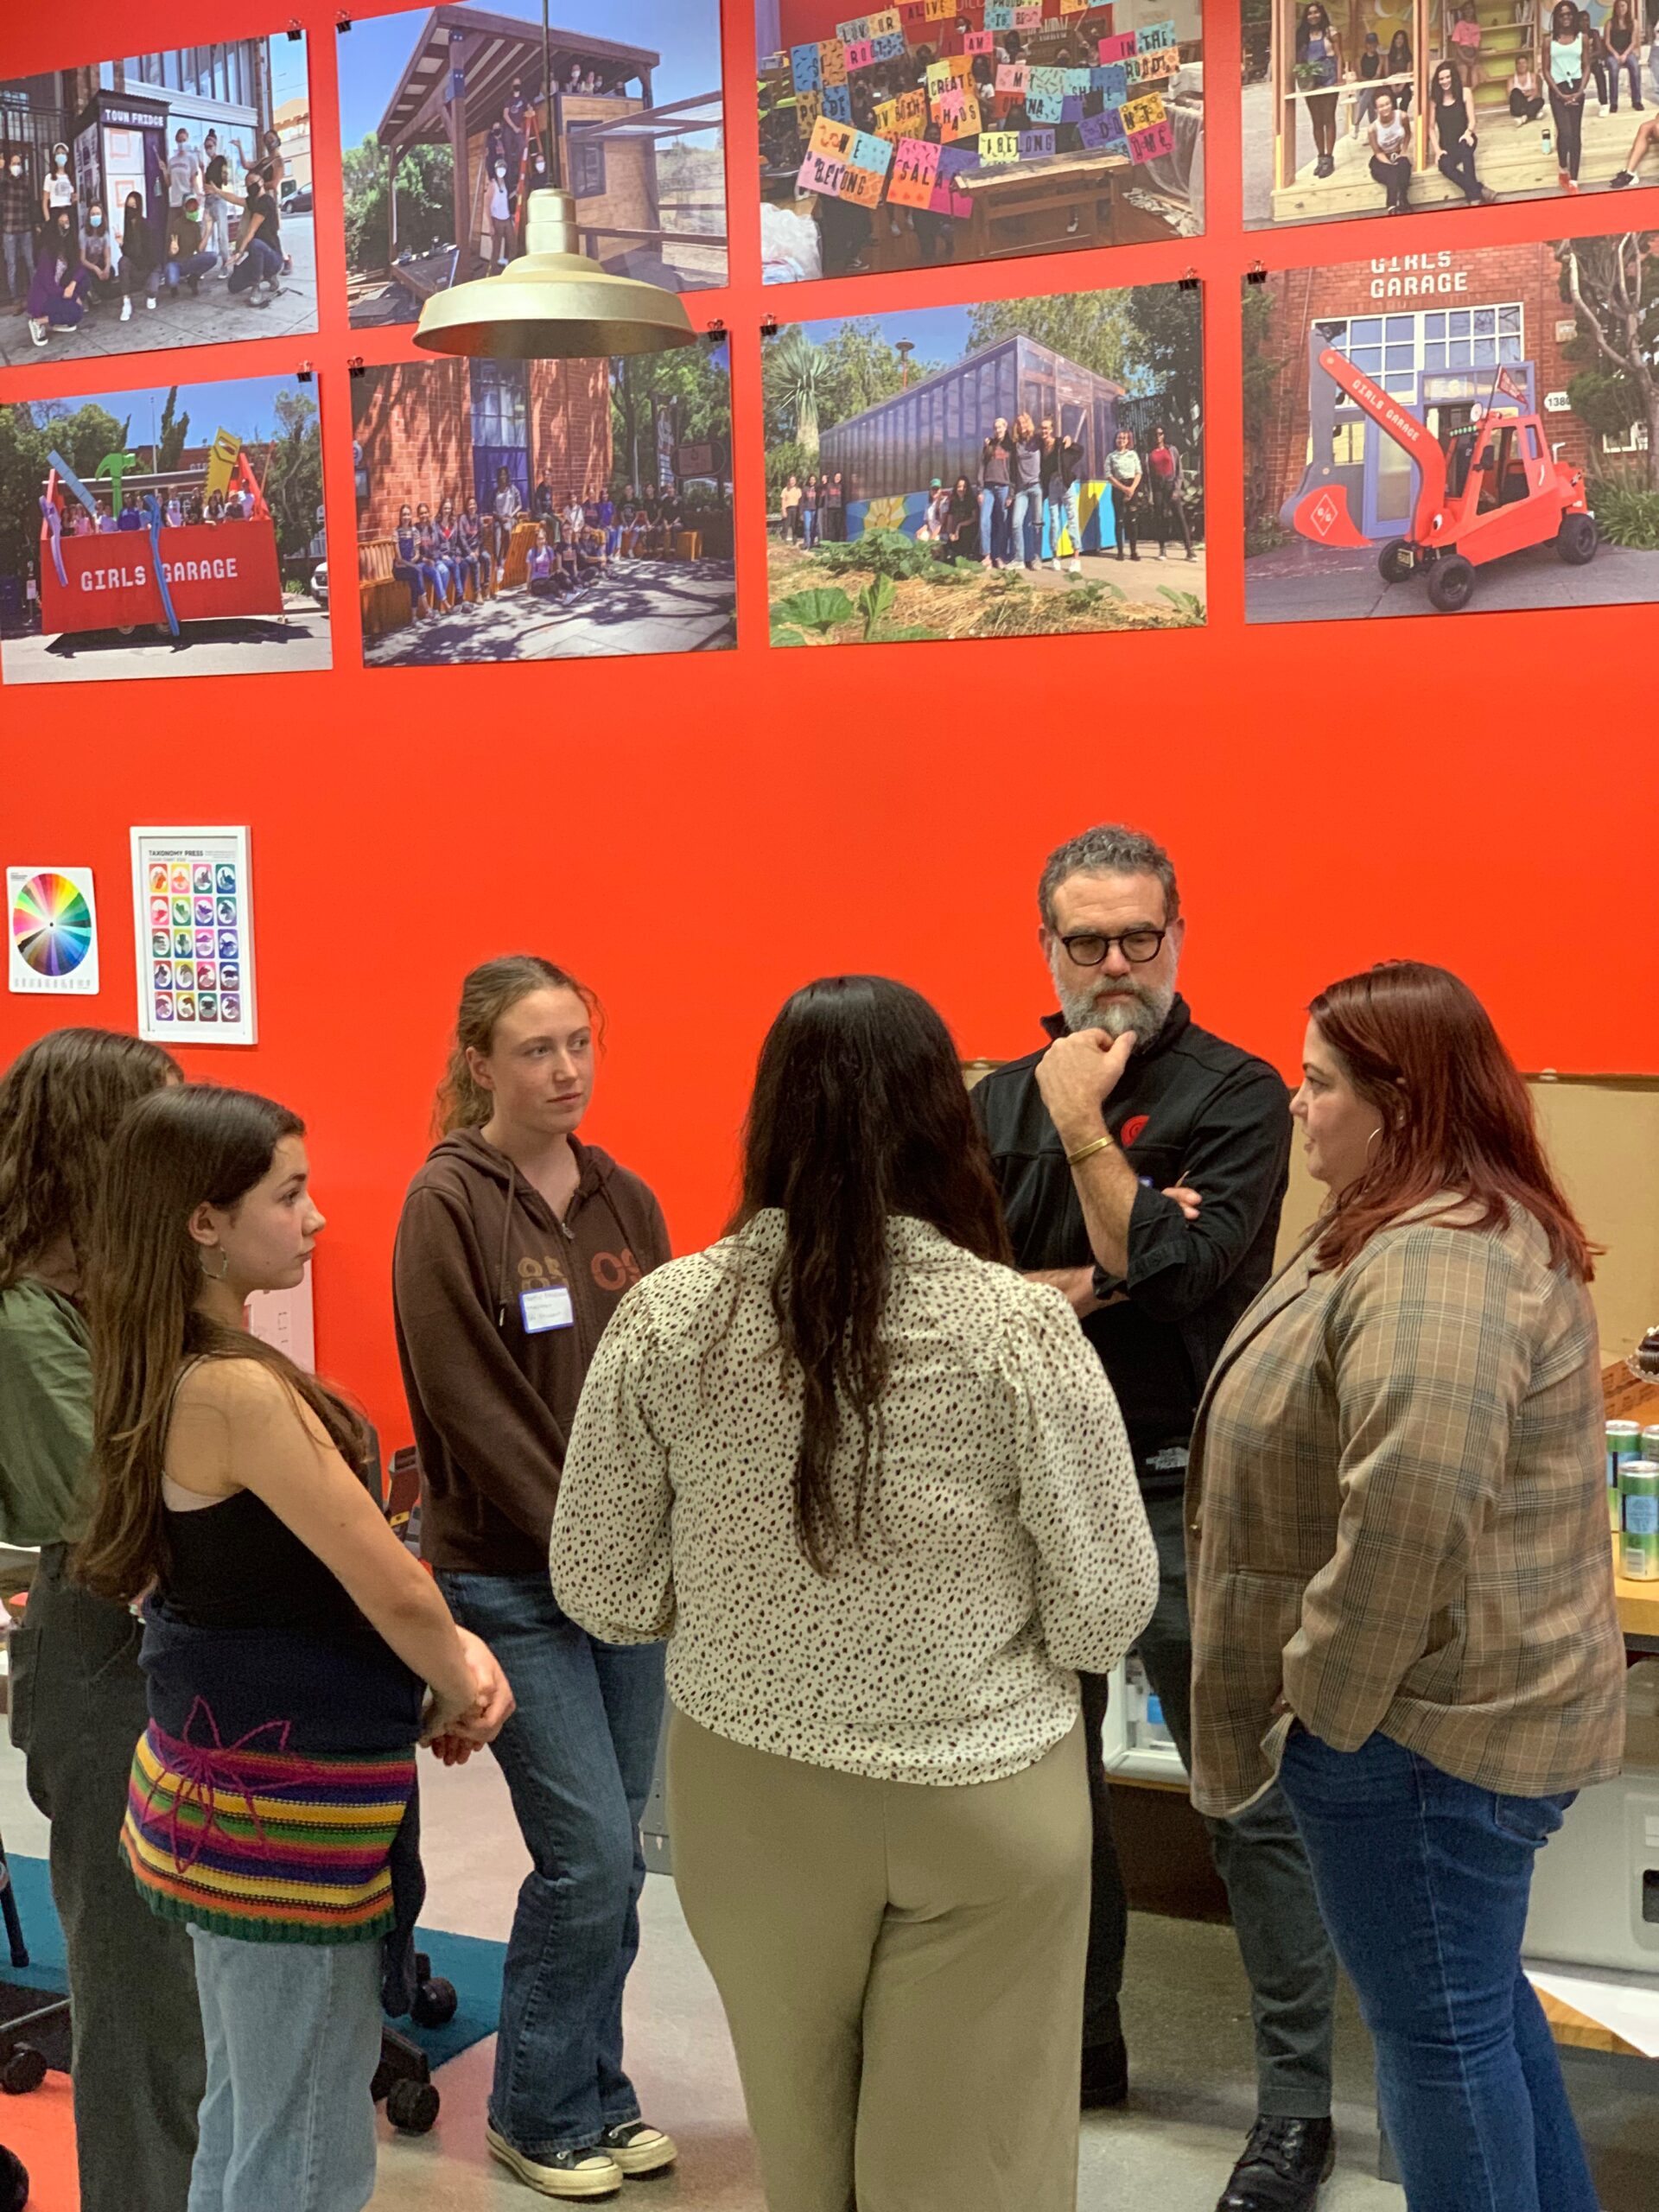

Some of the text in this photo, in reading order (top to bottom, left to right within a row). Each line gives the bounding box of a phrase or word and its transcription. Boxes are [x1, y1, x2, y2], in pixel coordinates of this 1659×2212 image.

[969, 36, 984, 51] AM
[1142, 29, 1167, 51] THE
[931, 72, 973, 96] CREATE
[105, 109, 164, 127] TOWN FRIDGE
[997, 134, 1052, 153] BELONG
[814, 159, 868, 195] BELONG
[1370, 251, 1452, 273] GIRLS
[1370, 271, 1468, 298] GARAGE
[1351, 379, 1421, 442] GIRLS GARAGE
[80, 557, 238, 592] GIRLS GARAGE
